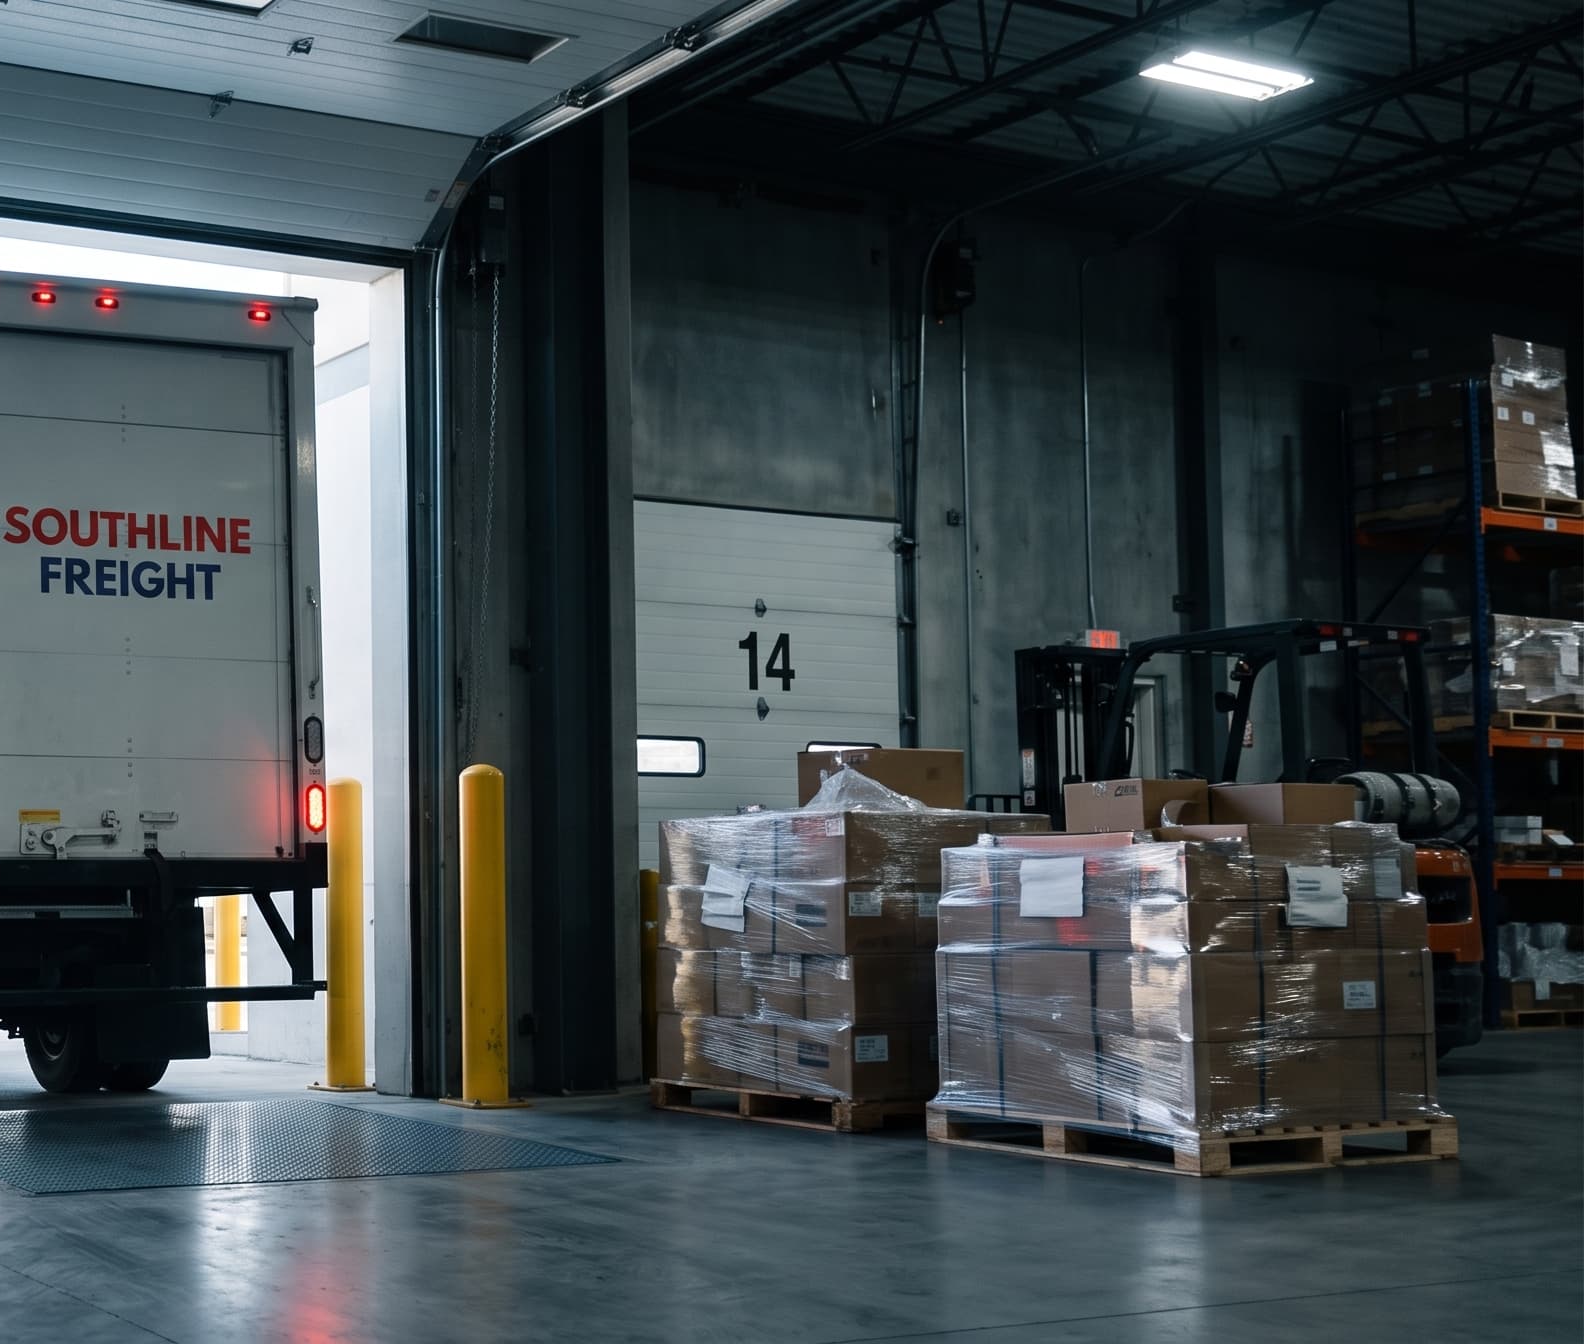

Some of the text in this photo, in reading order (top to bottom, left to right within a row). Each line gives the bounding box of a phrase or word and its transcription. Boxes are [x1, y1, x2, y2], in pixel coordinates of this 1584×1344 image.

[4, 507, 251, 554] SOUTHLINE
[41, 557, 221, 601] FREIGHT
[739, 632, 795, 691] 14
